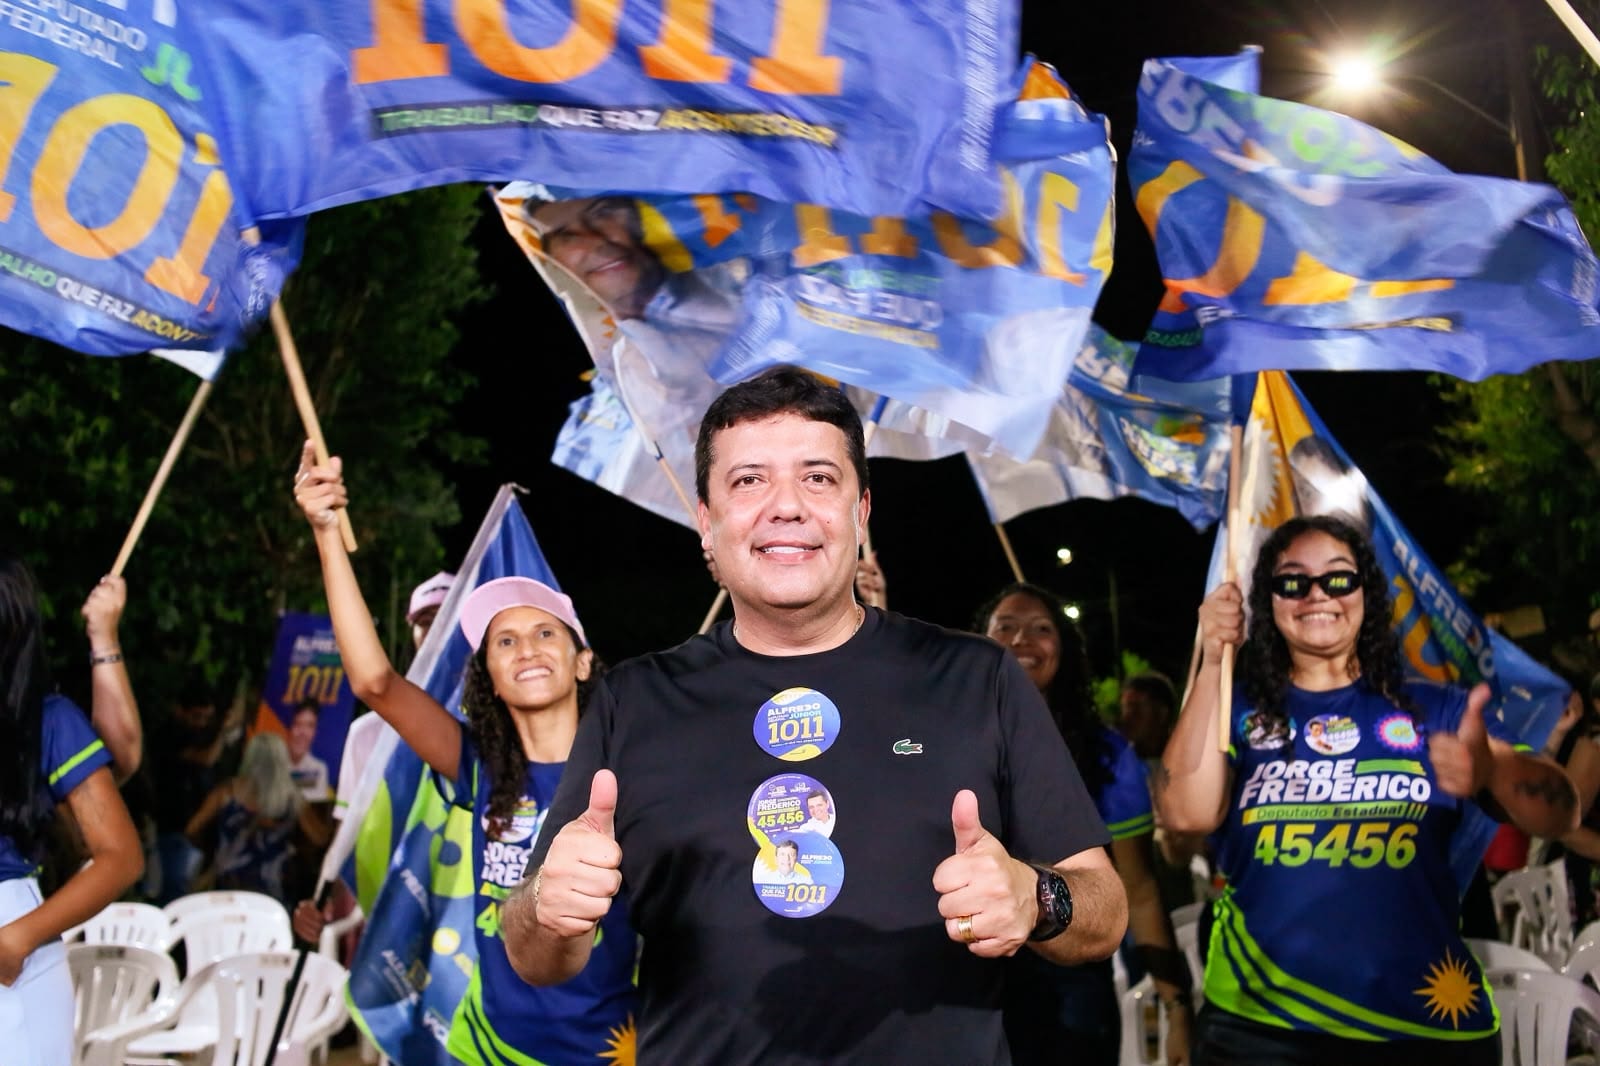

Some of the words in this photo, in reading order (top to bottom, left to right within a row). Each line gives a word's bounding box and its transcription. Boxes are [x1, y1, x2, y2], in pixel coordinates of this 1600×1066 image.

[56, 277, 102, 307] QUE
[98, 291, 136, 322] FAZ
[768, 703, 821, 717] ALFREDO
[768, 715, 825, 745] 1011
[1246, 758, 1356, 787] JORGE
[1238, 773, 1431, 810] FREDERICO
[1256, 808, 1328, 820] Deputado
[1332, 804, 1403, 819] Estadual
[1254, 821, 1419, 869] 45456
[785, 884, 827, 904] 1011
